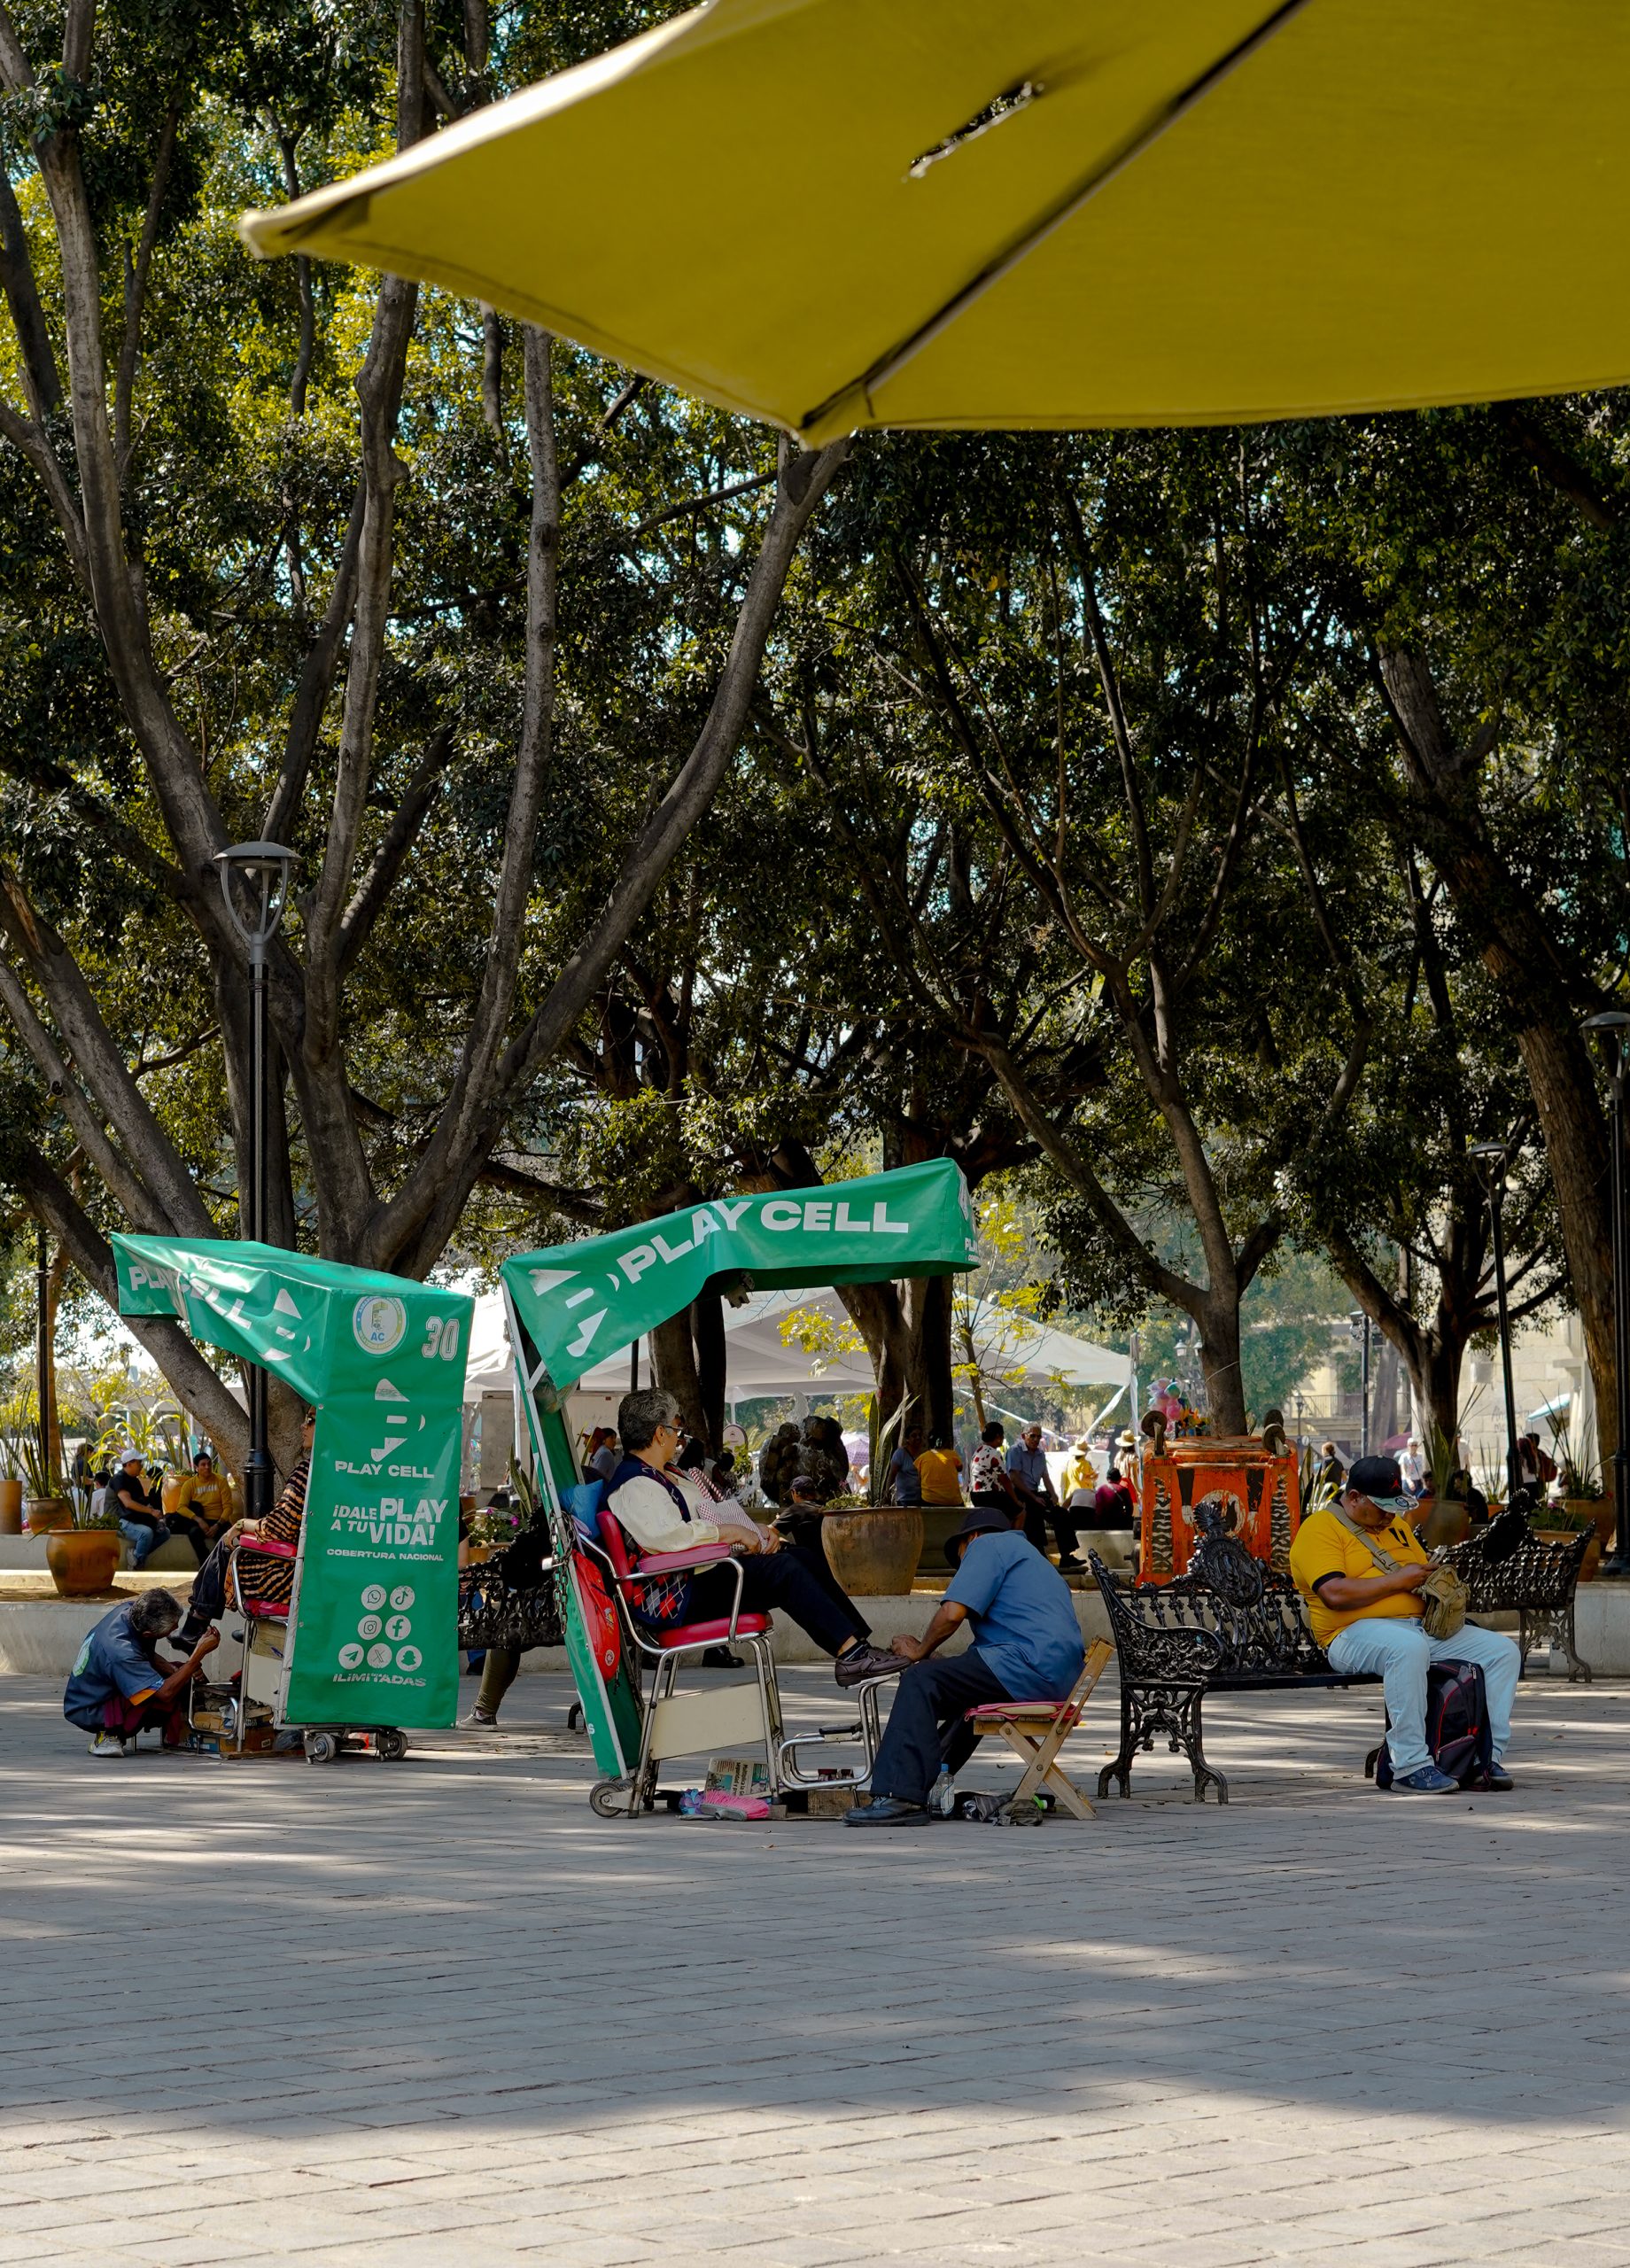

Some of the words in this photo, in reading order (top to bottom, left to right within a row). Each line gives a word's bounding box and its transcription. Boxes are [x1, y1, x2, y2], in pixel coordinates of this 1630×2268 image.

[617, 1200, 753, 1285] PLAY
[760, 1200, 909, 1234] CELL
[370, 1332, 385, 1341] AC
[422, 1316, 460, 1362] 30
[335, 1460, 383, 1476] PLAY
[388, 1464, 435, 1479] CELL
[332, 1504, 377, 1520] ¡DALE
[379, 1497, 449, 1524] PLAY
[330, 1518, 342, 1531] A
[346, 1520, 369, 1534] TU
[369, 1522, 436, 1546] VIDA!
[326, 1548, 396, 1560] COBERTURA
[399, 1553, 445, 1562] NACIONAL
